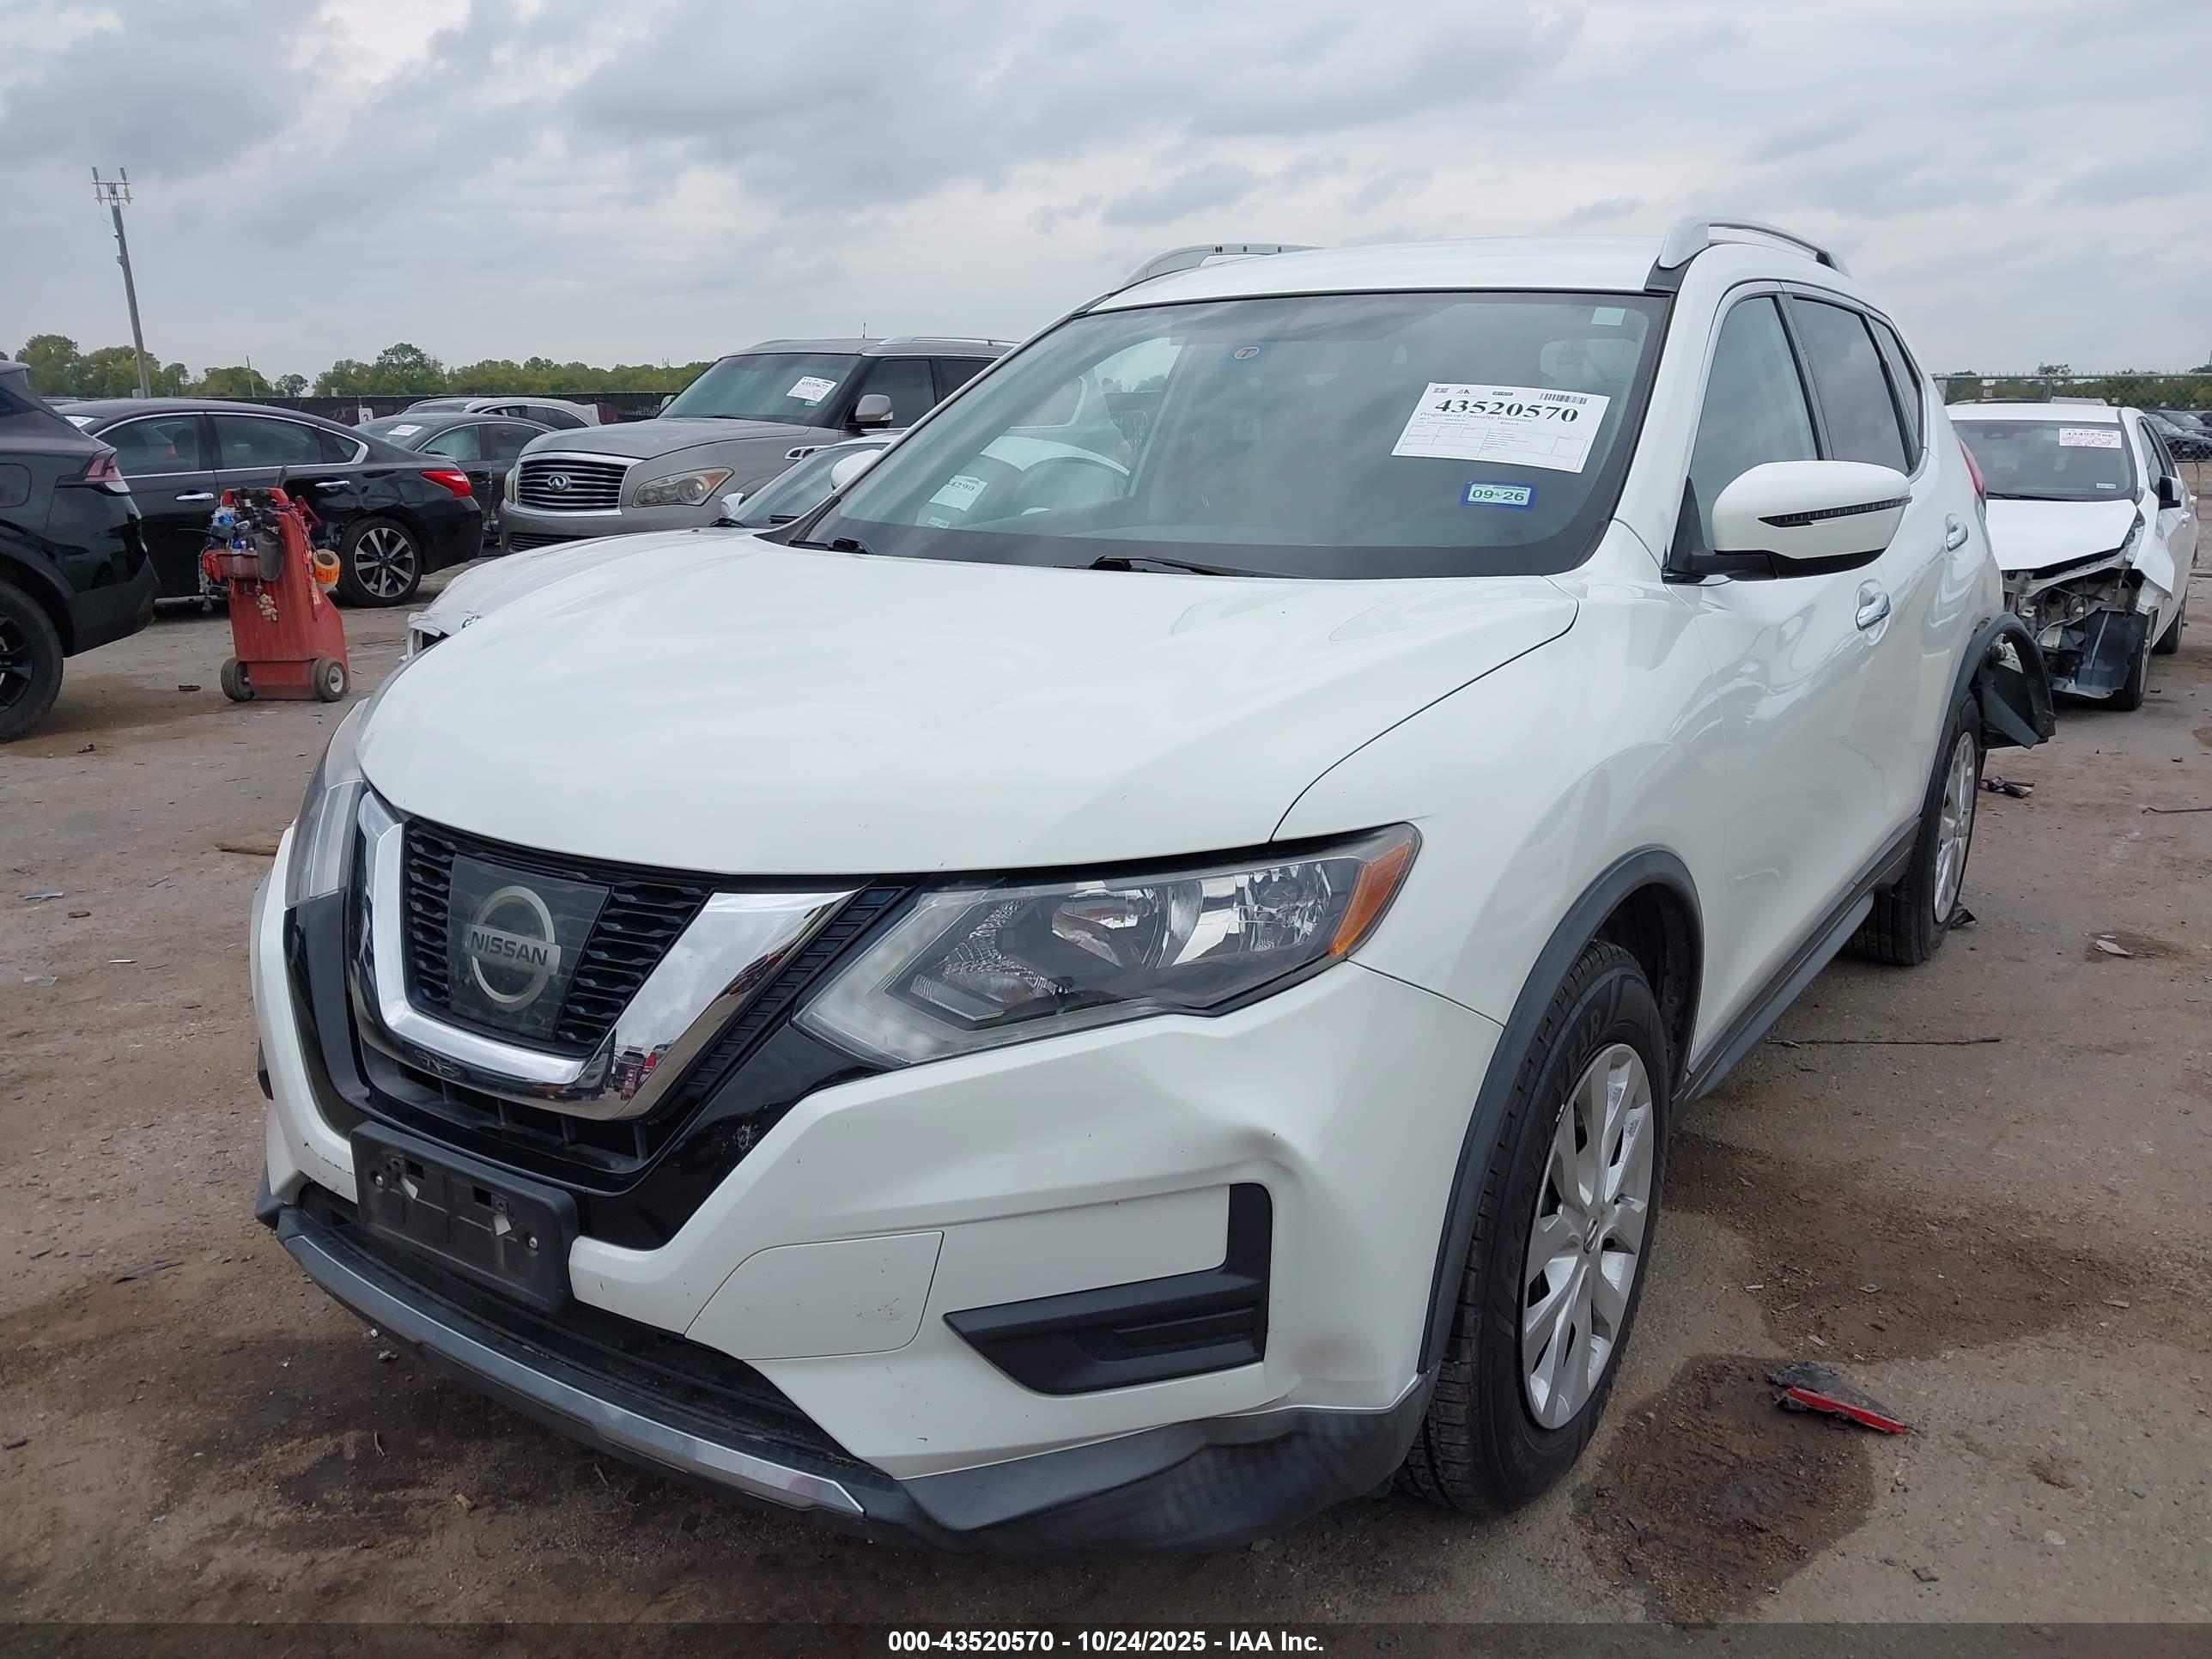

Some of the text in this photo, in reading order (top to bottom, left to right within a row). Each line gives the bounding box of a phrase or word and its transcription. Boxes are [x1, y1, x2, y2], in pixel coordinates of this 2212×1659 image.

[1419, 411, 1462, 420] Progressive
[1497, 415, 1533, 423] Insurance
[1434, 398, 1579, 422] 43520570
[470, 931, 549, 967] NISSAN
